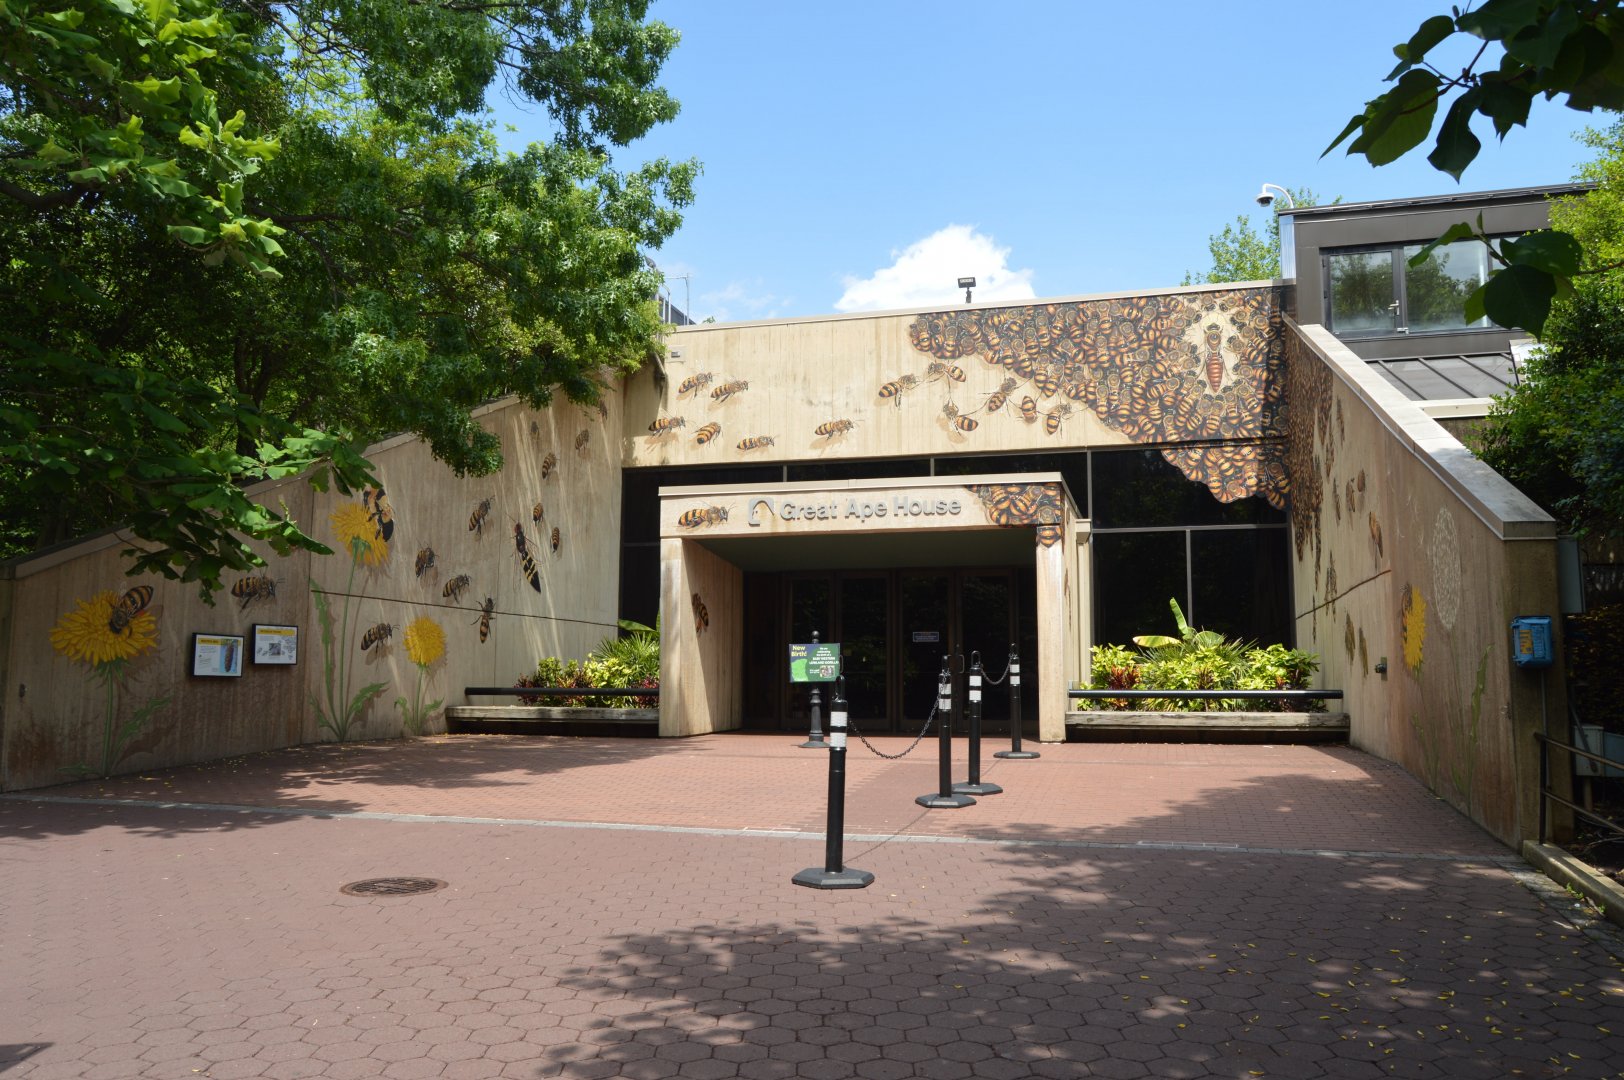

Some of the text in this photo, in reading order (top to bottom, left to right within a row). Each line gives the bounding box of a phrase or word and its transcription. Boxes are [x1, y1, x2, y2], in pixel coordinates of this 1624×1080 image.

[780, 496, 962, 523] Great Ape House
